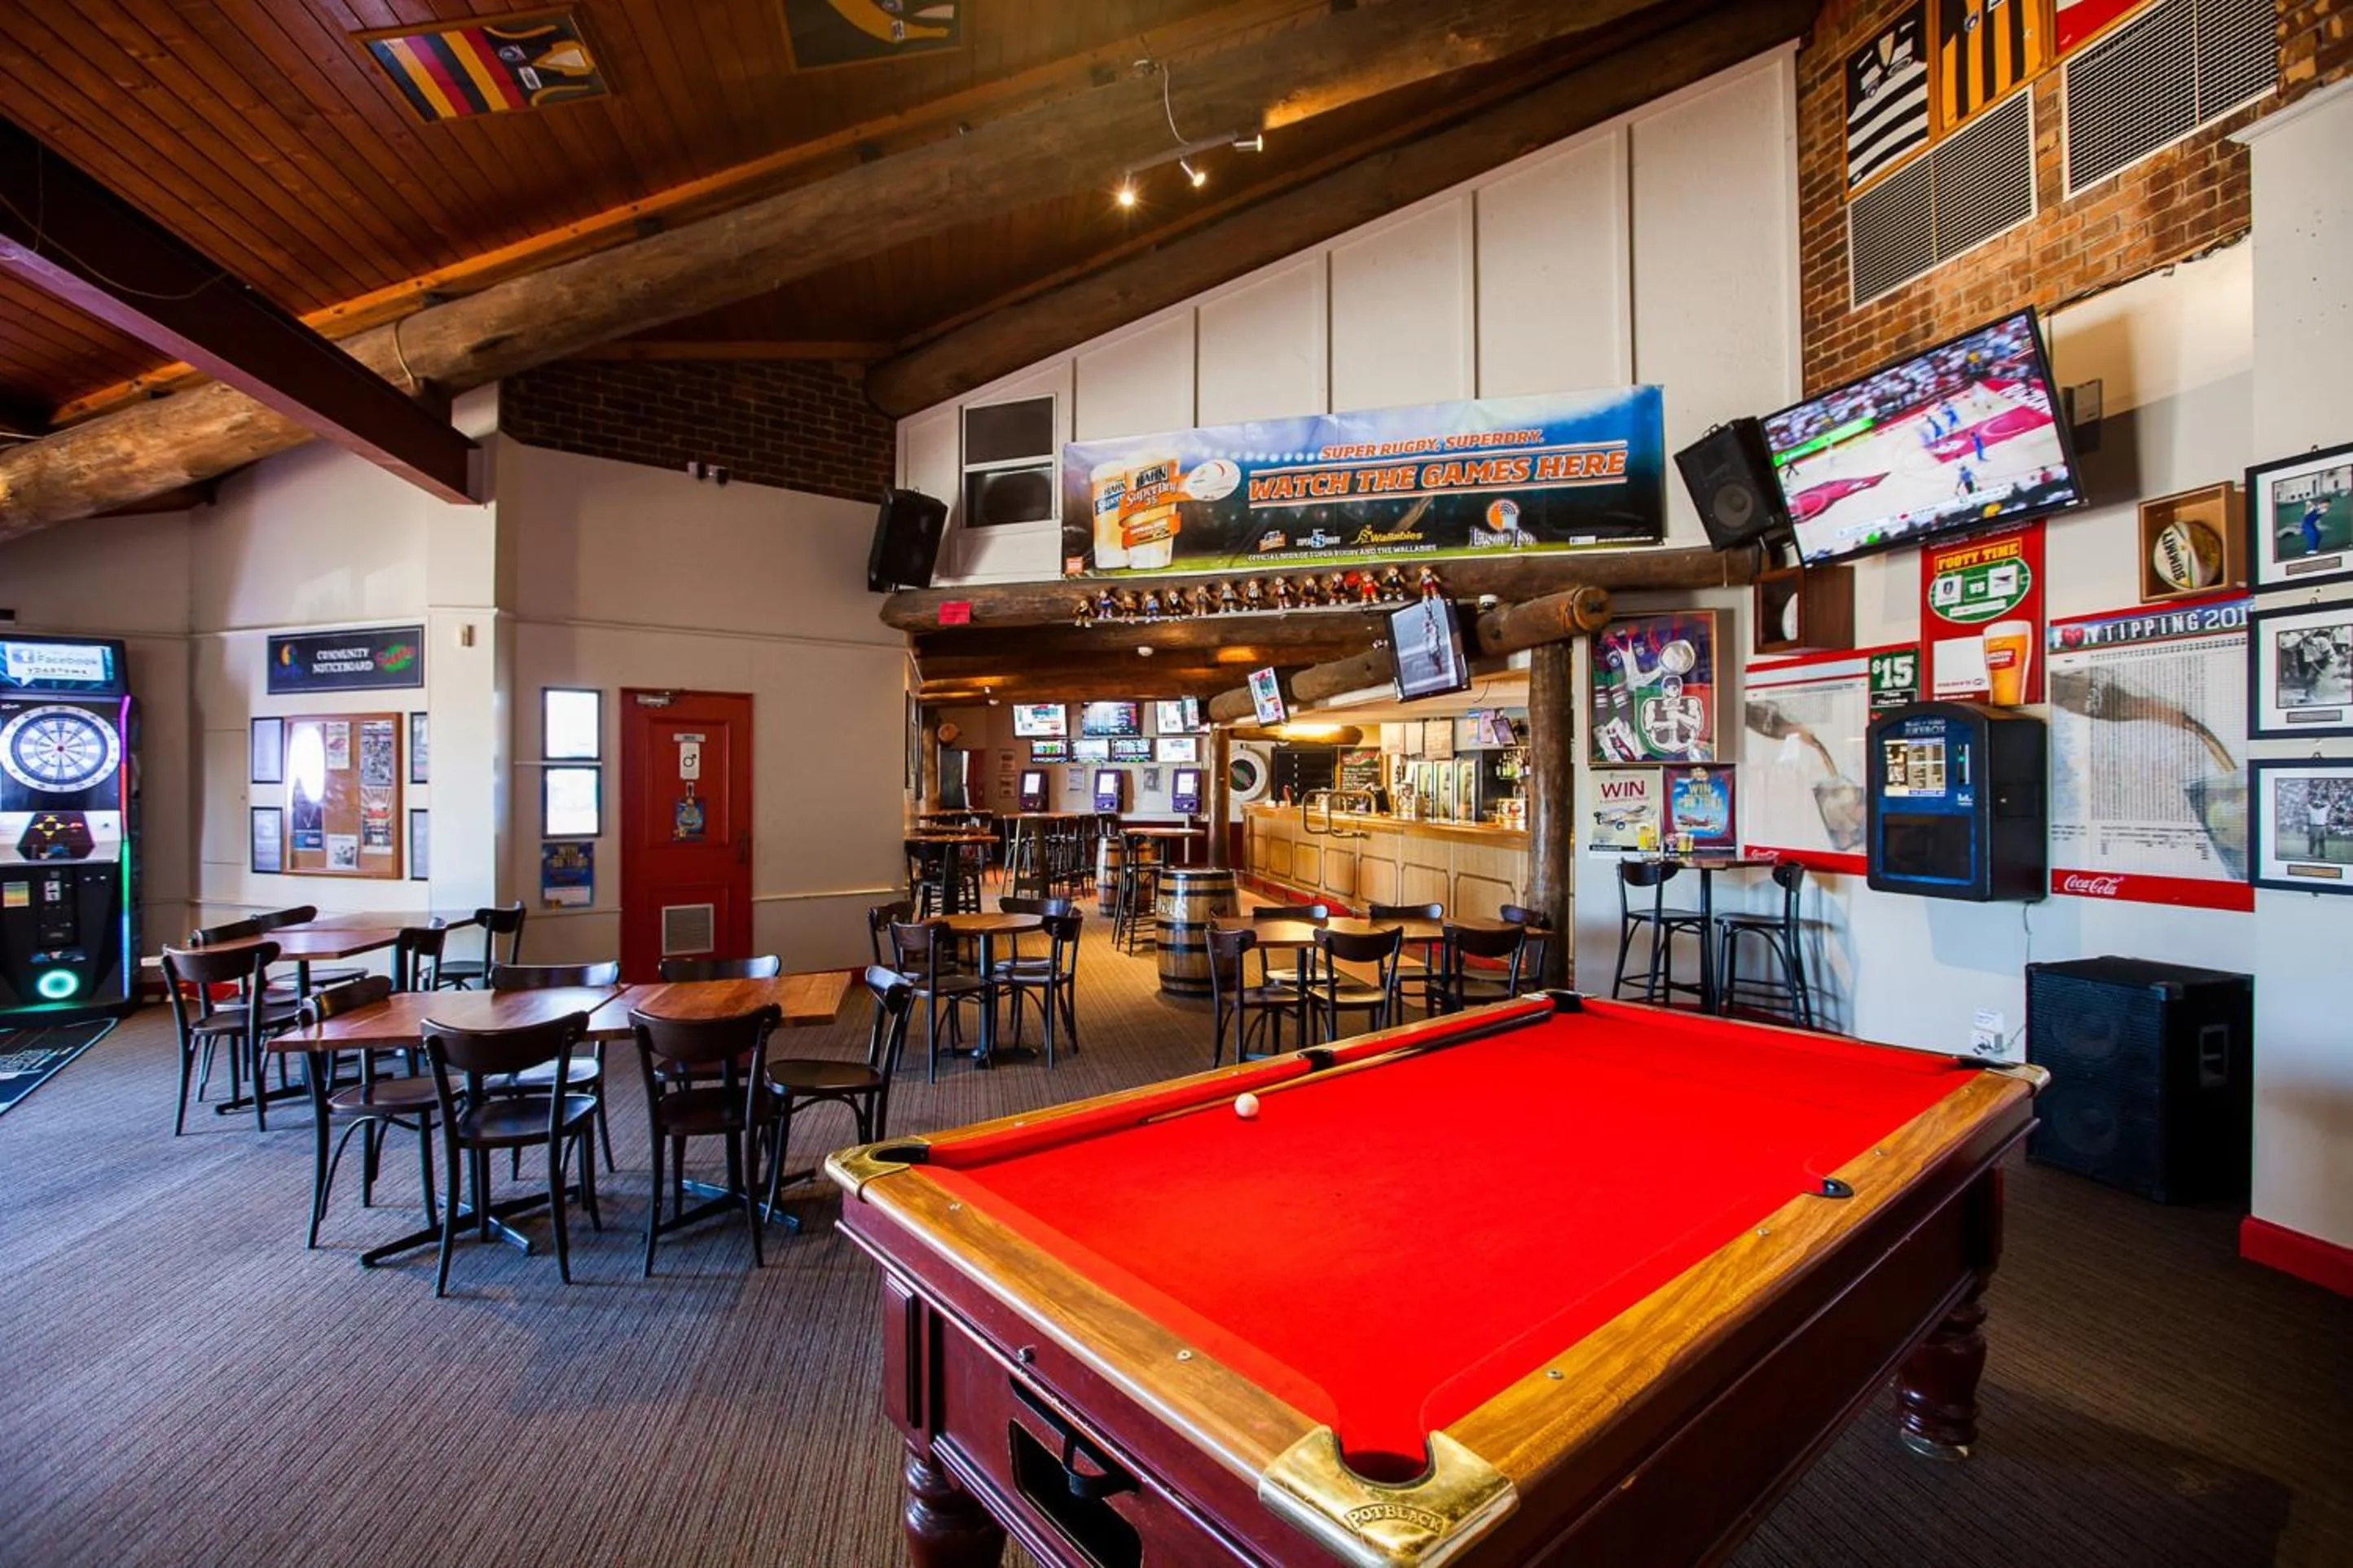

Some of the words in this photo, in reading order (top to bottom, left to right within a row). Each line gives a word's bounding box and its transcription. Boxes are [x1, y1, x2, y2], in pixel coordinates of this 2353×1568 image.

[1322, 446, 1375, 460] SUPER
[1446, 431, 1544, 448] SUPERDRY.
[1248, 471, 1351, 501] WATCH
[1357, 465, 1418, 493] THE
[1422, 457, 1532, 488] GAMES
[1535, 449, 1629, 480] HERE
[1370, 531, 1423, 542] Wallabies
[1939, 551, 1979, 570] FOOTY
[1981, 542, 2019, 560] TIME
[2105, 612, 2199, 642] TIPPING
[2205, 606, 2255, 630] 201
[312, 661, 375, 674] NOTICEBOARD
[316, 648, 370, 661] COMMUNITY
[1871, 655, 1915, 689] $15
[1601, 780, 1645, 798] WIN
